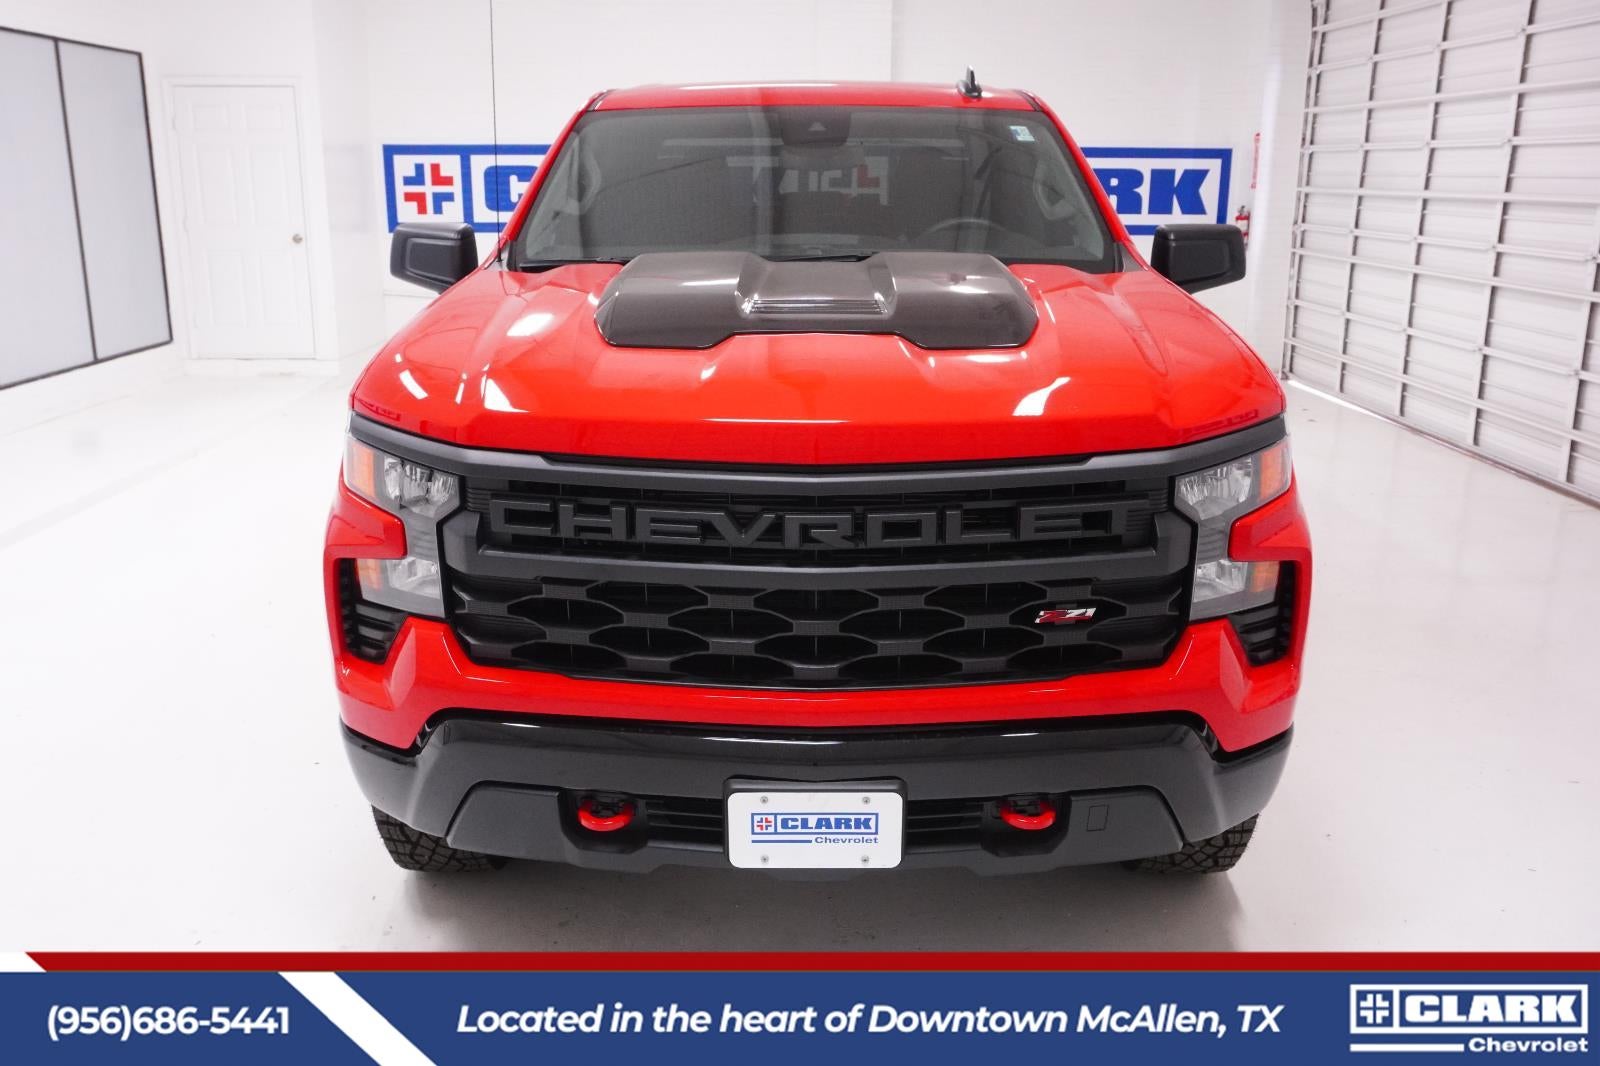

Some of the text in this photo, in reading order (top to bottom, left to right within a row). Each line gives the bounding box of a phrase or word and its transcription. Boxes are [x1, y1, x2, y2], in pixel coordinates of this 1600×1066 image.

[489, 499, 1148, 550] CHEVROLET
[1035, 607, 1096, 624] Z71
[780, 817, 872, 830] CLARK
[814, 836, 879, 844] Chevrolet
